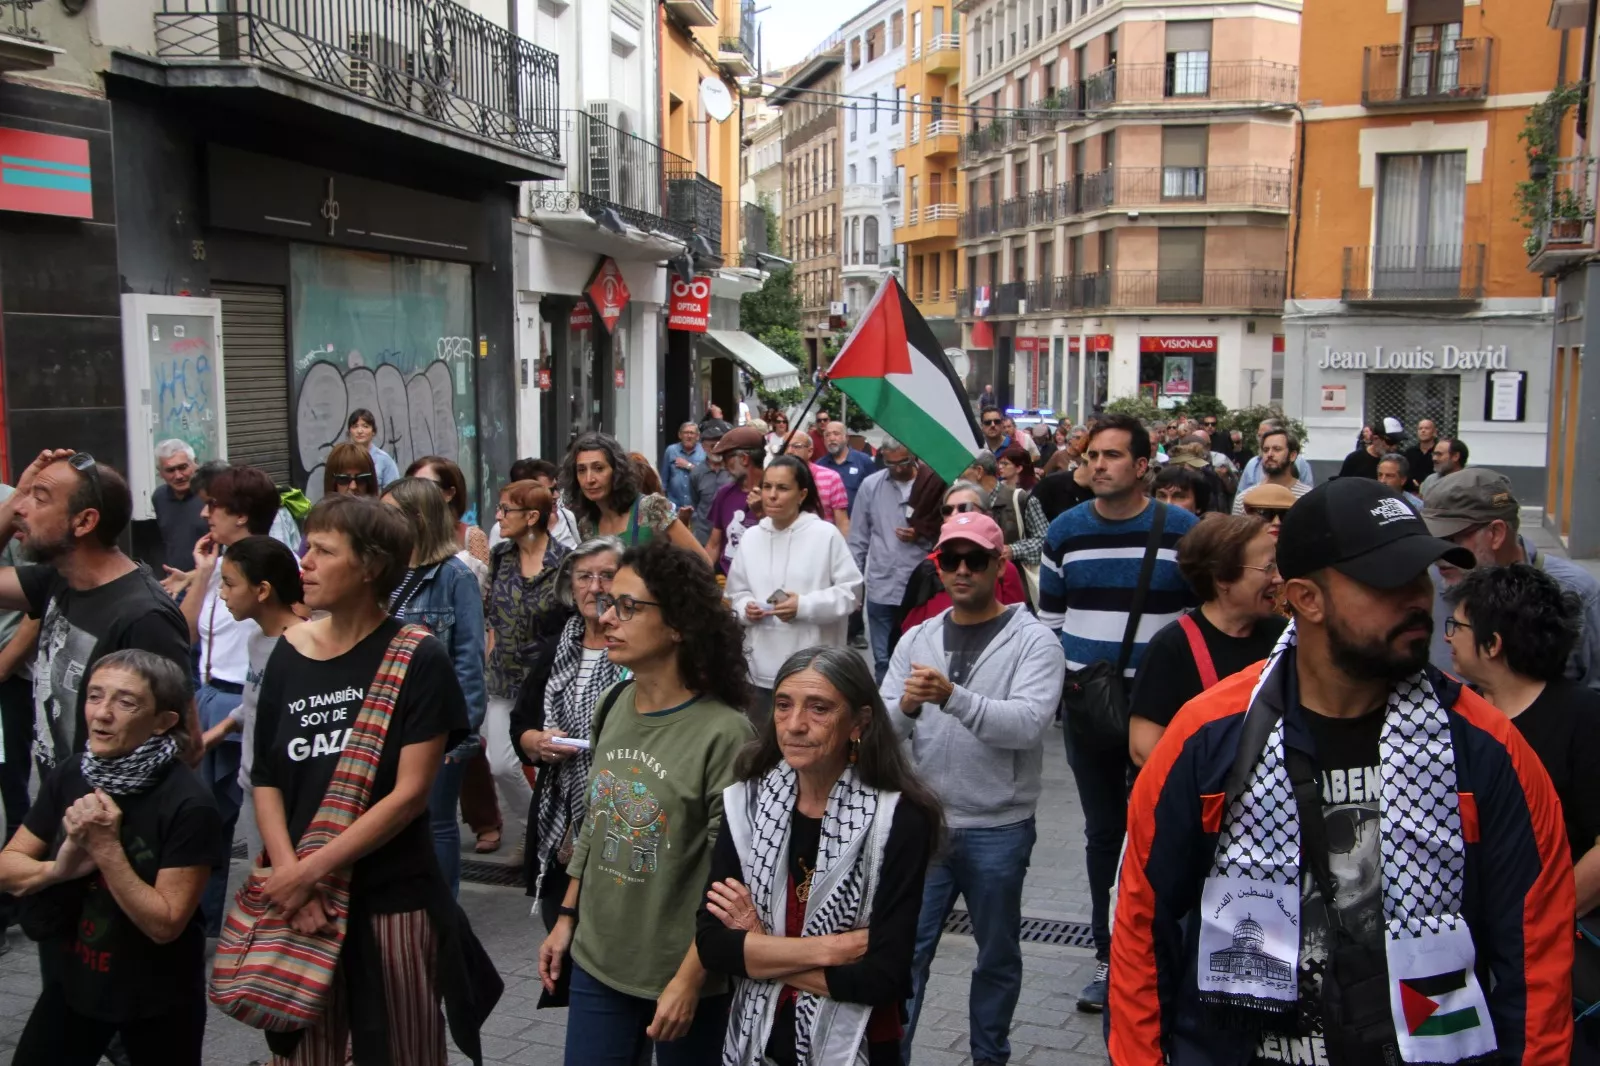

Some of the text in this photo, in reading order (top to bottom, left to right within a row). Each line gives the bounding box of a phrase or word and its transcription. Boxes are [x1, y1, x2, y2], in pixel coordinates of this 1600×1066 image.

[1160, 339, 1213, 349] VISIONLAB
[1319, 344, 1507, 369] Jean Louis David
[1378, 498, 1397, 506] THE
[1382, 509, 1404, 519] FACE
[288, 686, 364, 714] YO TAMBIÉN
[300, 708, 348, 727] SOY DE
[606, 748, 668, 780] WELLNESS
[1213, 886, 1298, 927] عاصمة فلسطين القدس
